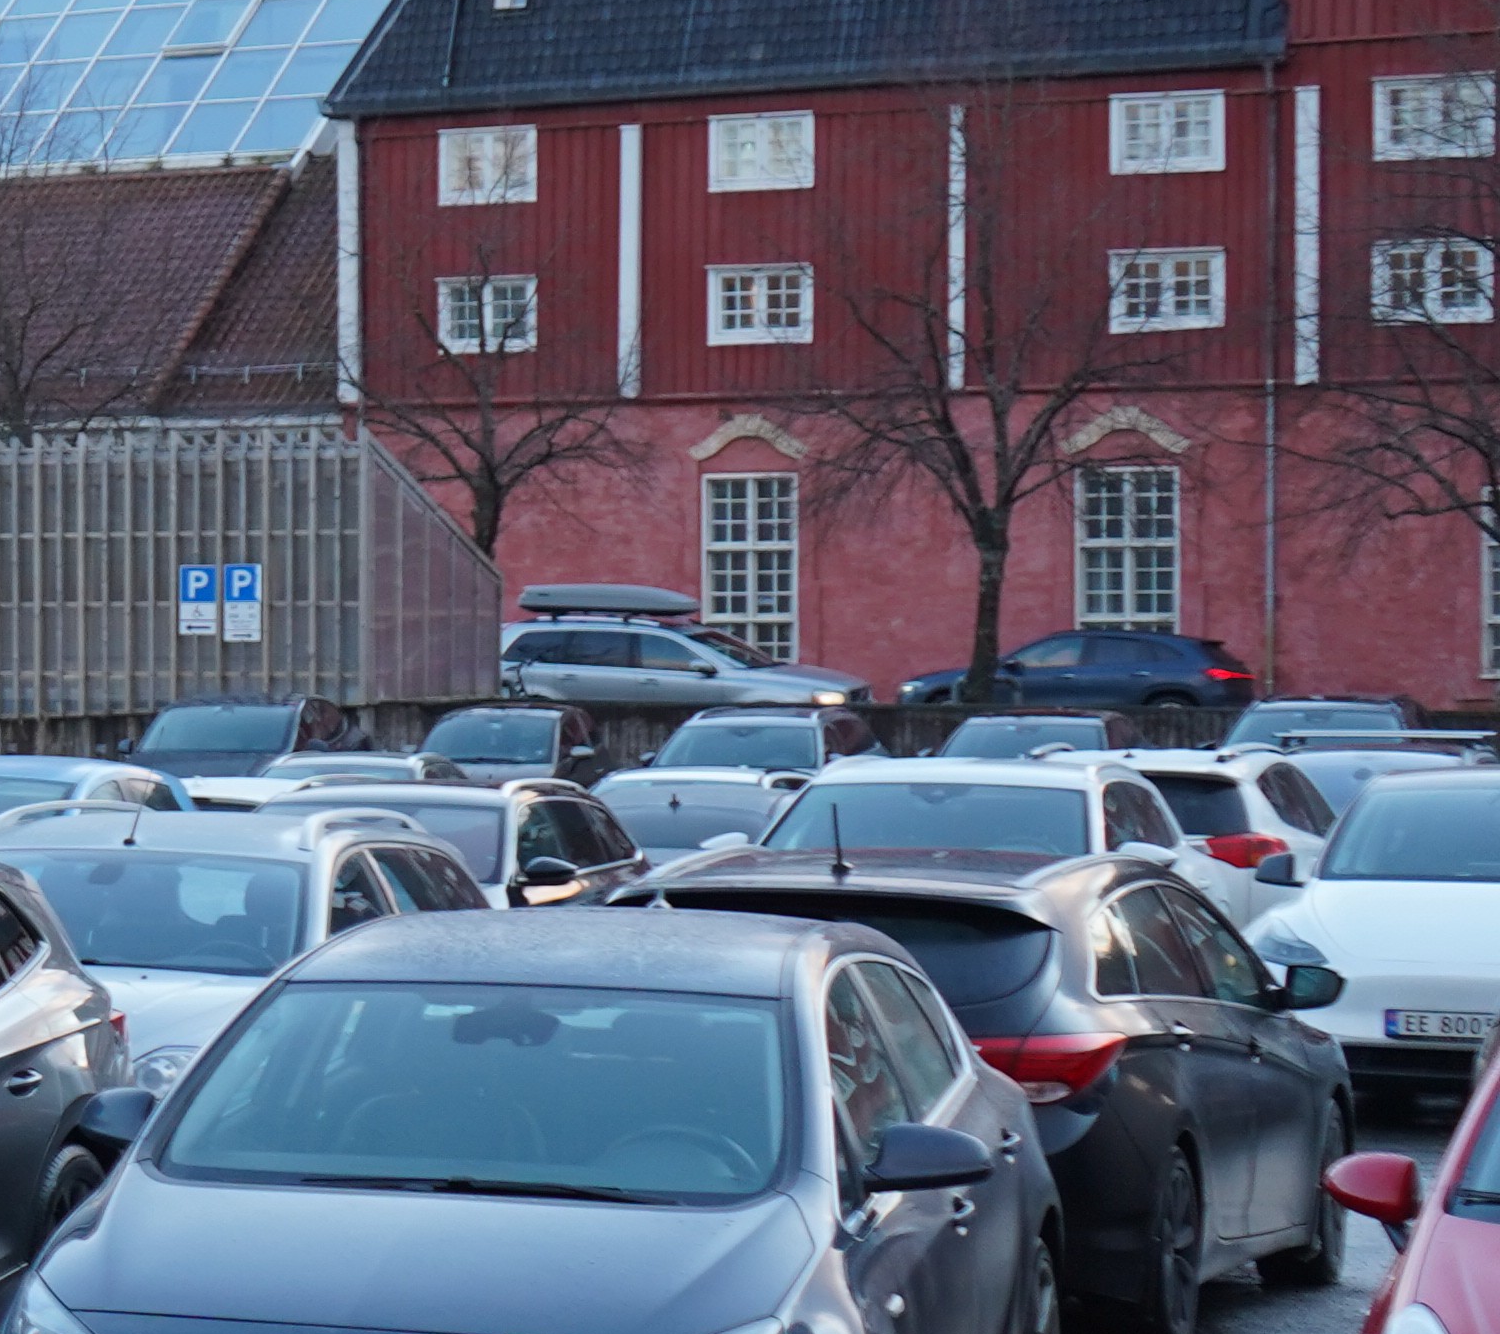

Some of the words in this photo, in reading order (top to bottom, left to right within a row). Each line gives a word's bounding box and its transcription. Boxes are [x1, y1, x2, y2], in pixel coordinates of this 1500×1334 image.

[188, 570, 209, 599] P
[232, 569, 253, 598] P
[1405, 1014, 1429, 1033] EE
